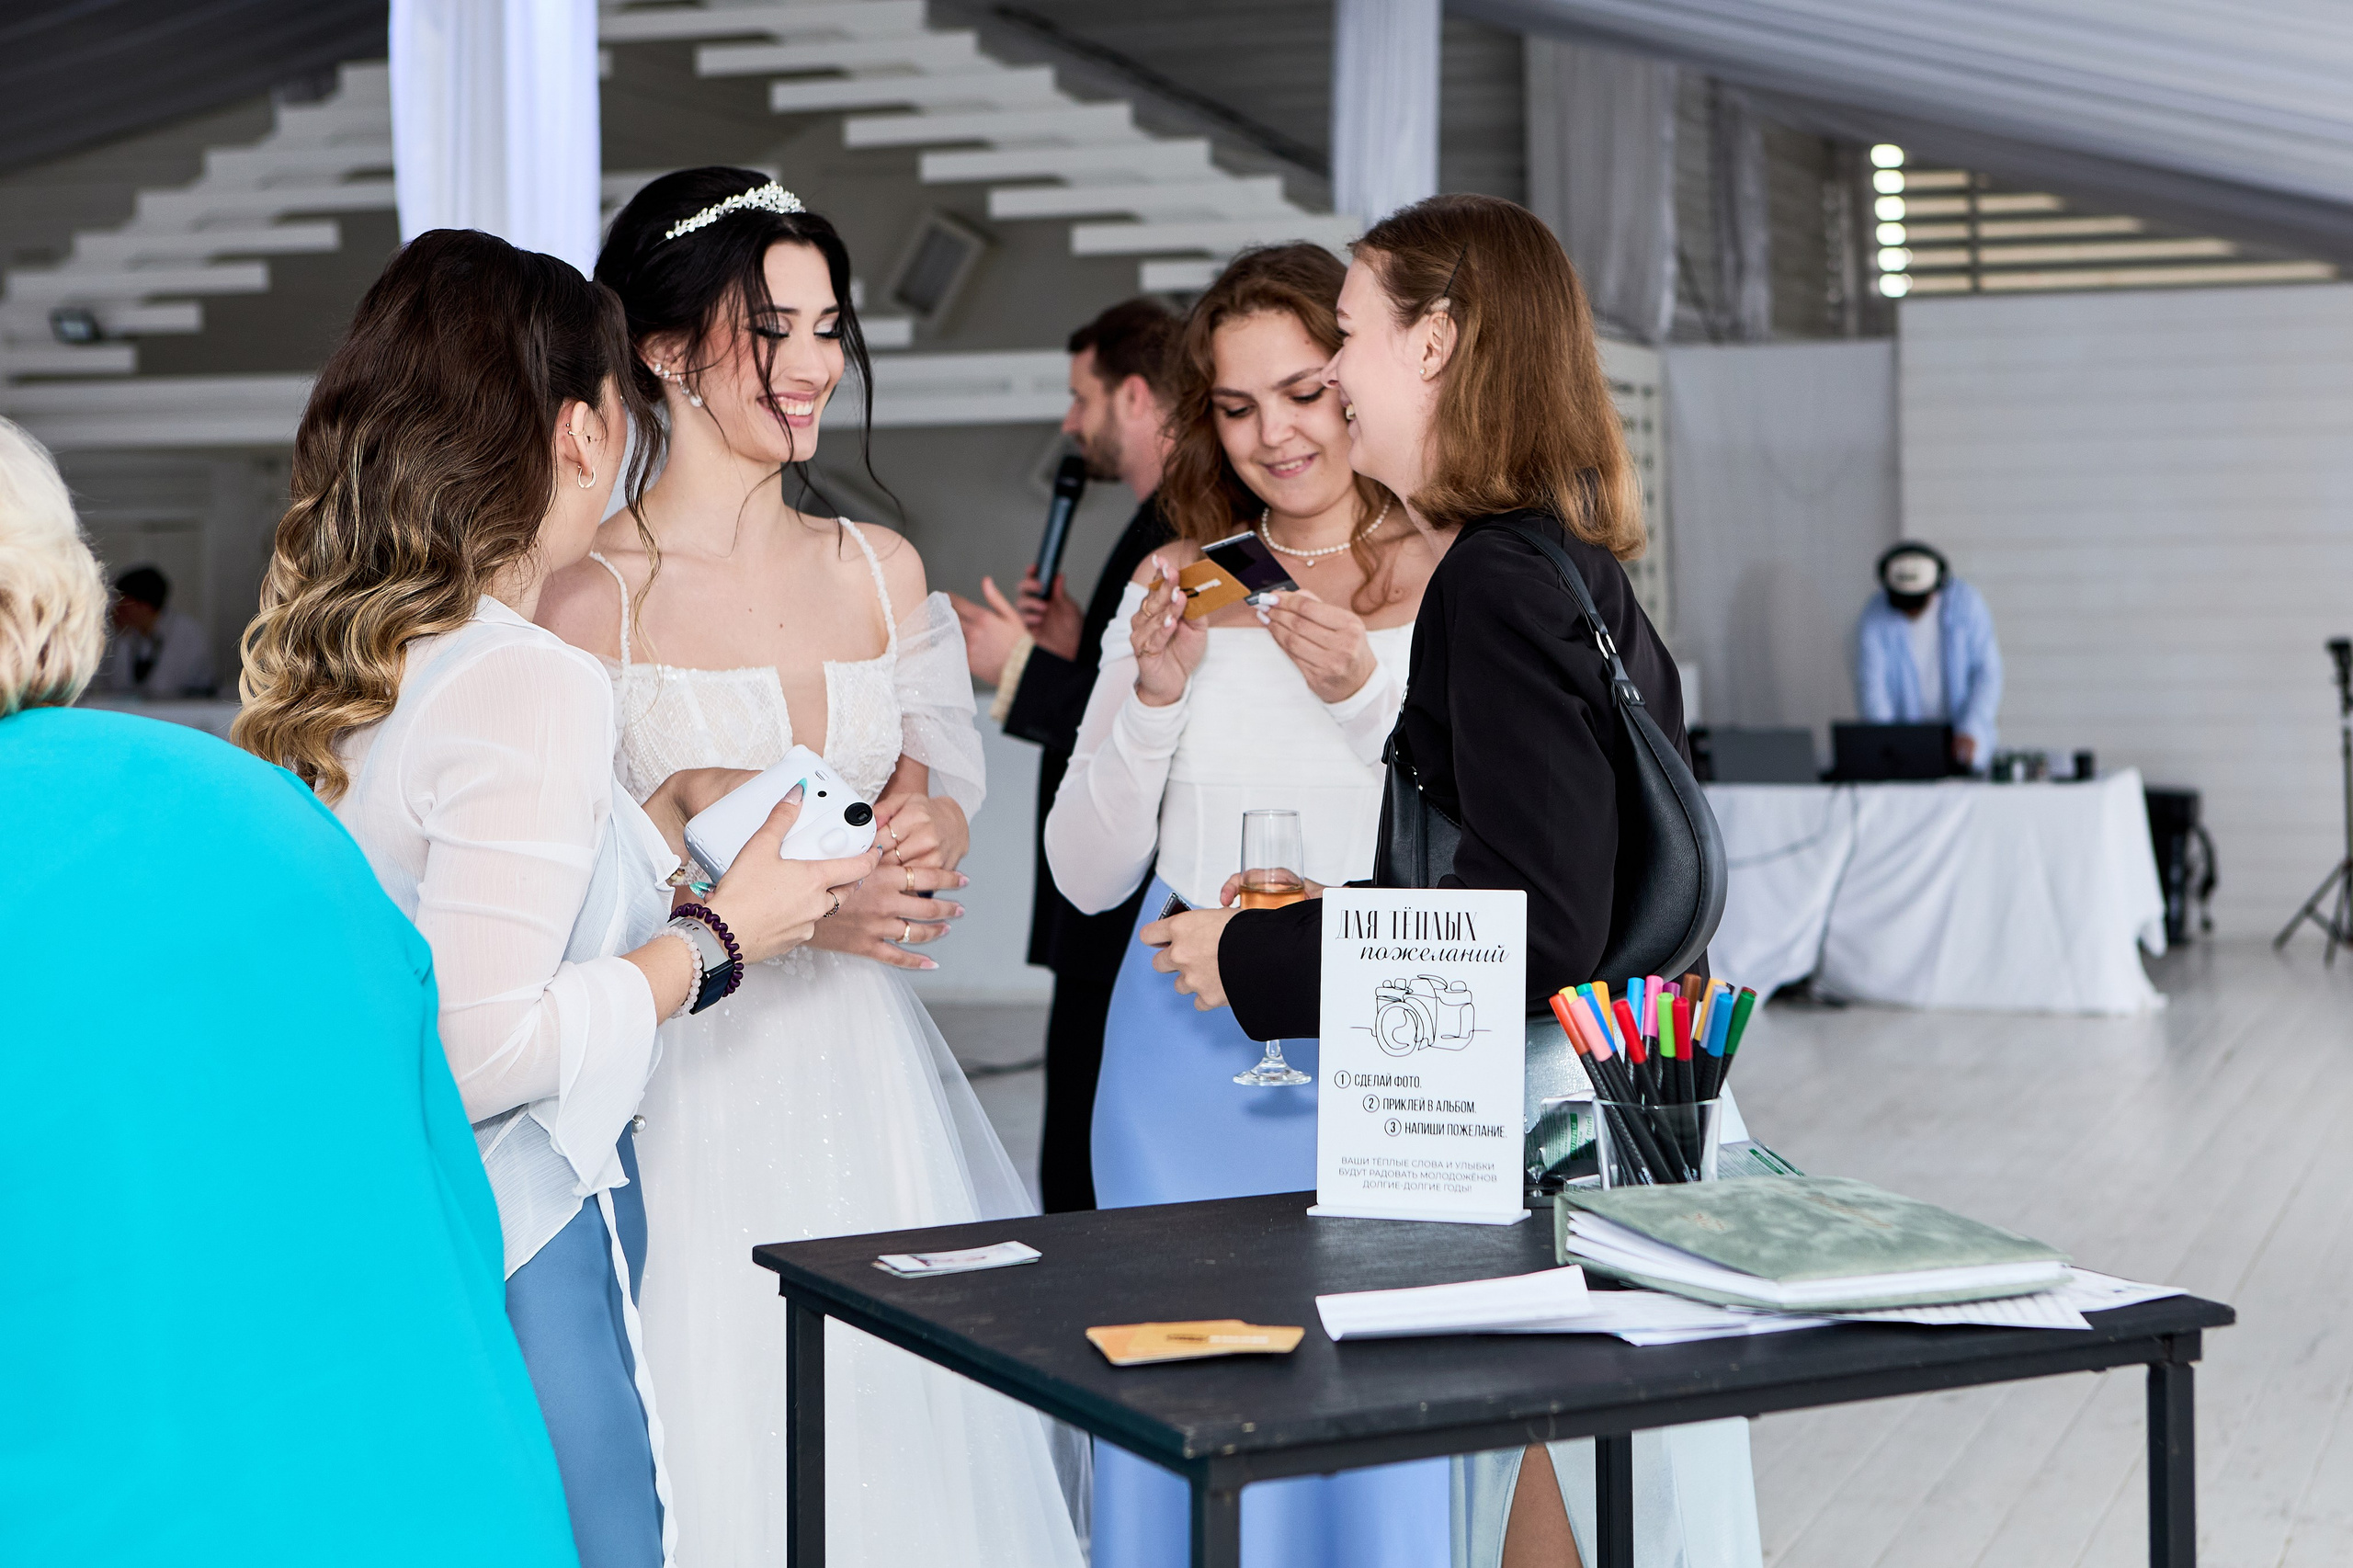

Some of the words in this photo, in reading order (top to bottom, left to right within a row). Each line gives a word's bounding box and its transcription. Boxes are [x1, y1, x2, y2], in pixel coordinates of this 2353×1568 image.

[1336, 909, 1378, 941] ДЛЯ
[1389, 906, 1478, 941] ТЁПЛЫХ
[1360, 944, 1510, 963] пожеланий
[1354, 1073, 1392, 1088] СДЕЛАЙ
[1393, 1075, 1423, 1089] ФОТО.
[1382, 1096, 1426, 1112] ПРИКЛЕЙ
[1427, 1099, 1434, 1112] В
[1436, 1100, 1477, 1114] АЛЬБОМ.
[1404, 1122, 1445, 1135] НАПИШИ
[1447, 1123, 1507, 1139] ПОЖЕЛАНИЕ.
[1341, 1156, 1370, 1165] ВАШИ
[1411, 1160, 1444, 1169] СЛОВА
[1446, 1161, 1453, 1169] И
[1455, 1161, 1495, 1171] УЛЫБКИ
[1338, 1167, 1368, 1177] БУДУТ
[1369, 1169, 1418, 1180] РАДОВАТЬ
[1362, 1180, 1441, 1192] ДОЛГИЕ-ДОЛГИЕ
[1444, 1182, 1472, 1194] ГОДЫ!
